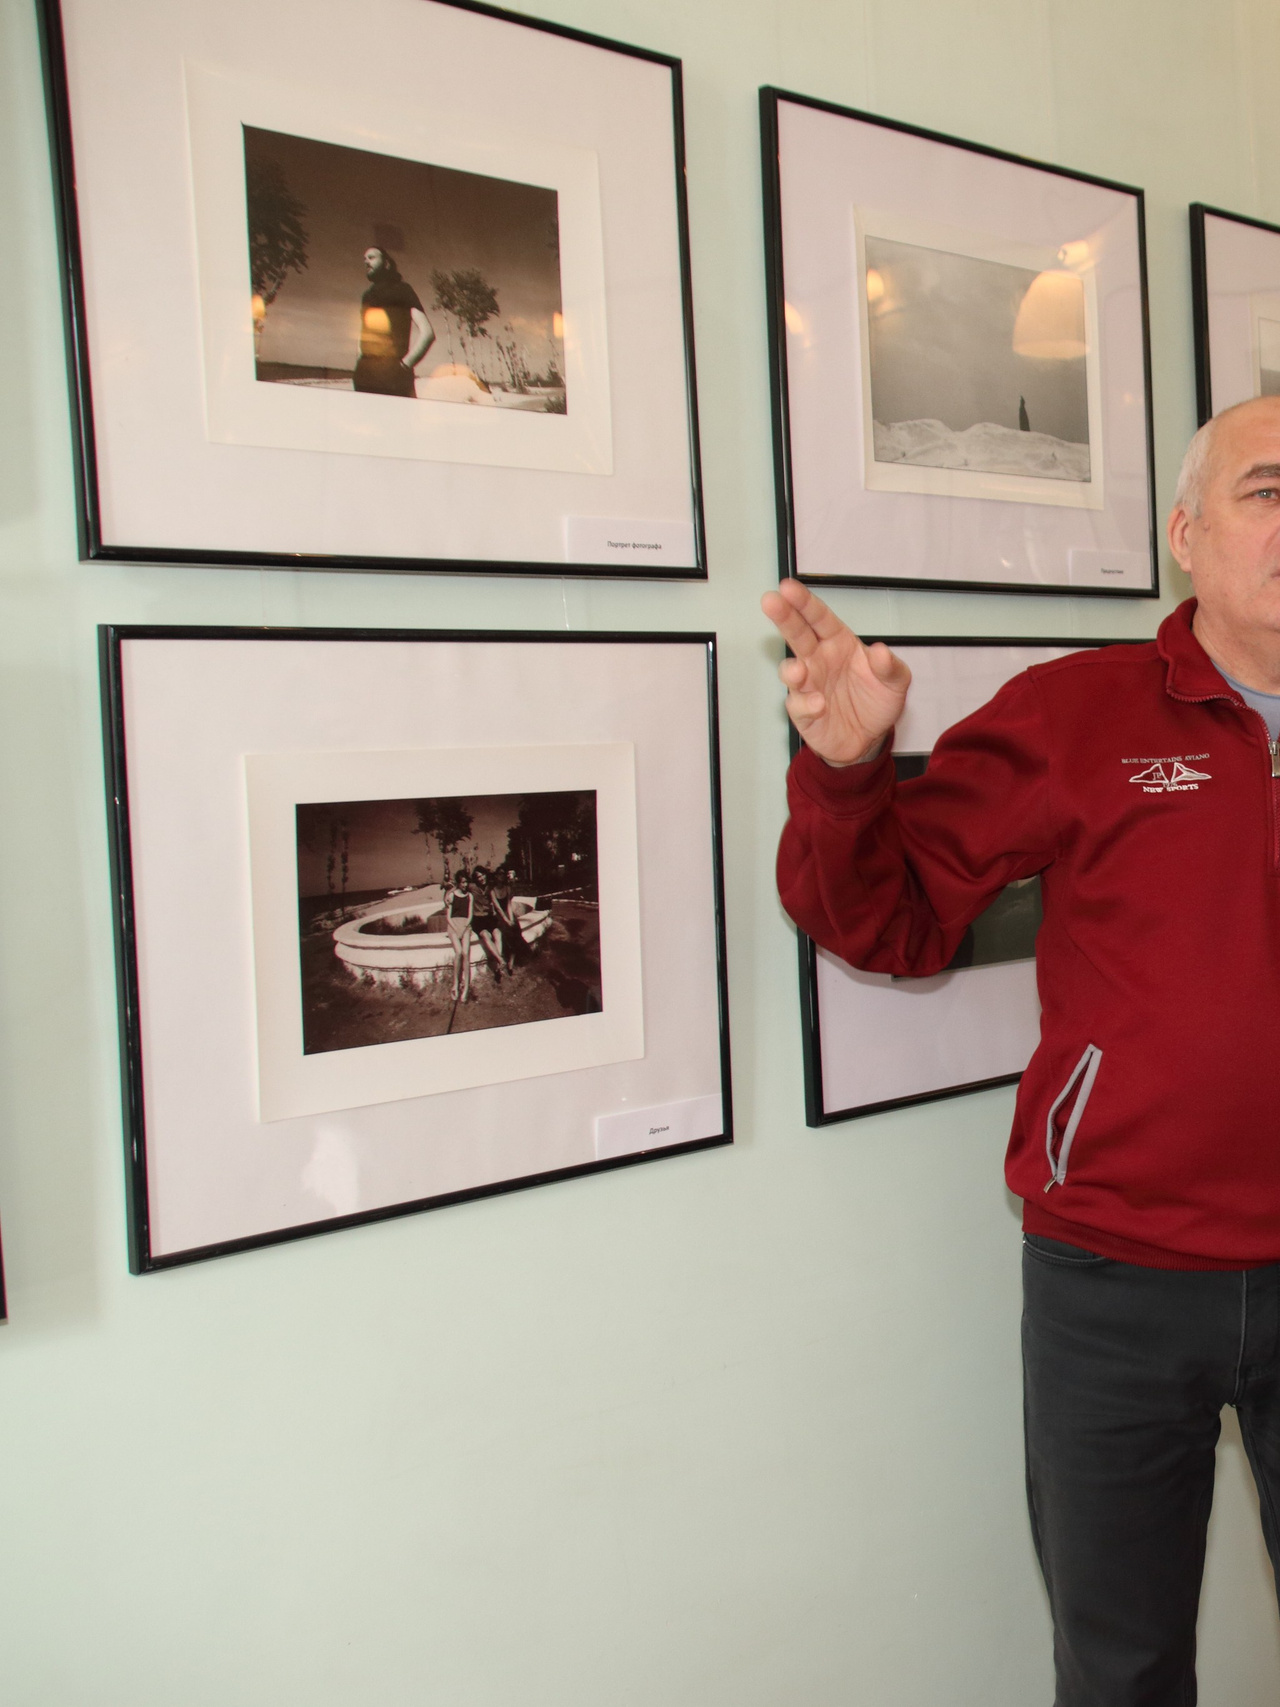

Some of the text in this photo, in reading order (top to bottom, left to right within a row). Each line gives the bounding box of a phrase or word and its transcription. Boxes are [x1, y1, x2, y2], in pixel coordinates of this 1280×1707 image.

[607, 540, 662, 550] Портрет фотографа
[1151, 771, 1162, 781] JP
[1142, 783, 1199, 793] NEW SPORTS
[648, 1125, 670, 1135] Друзья
